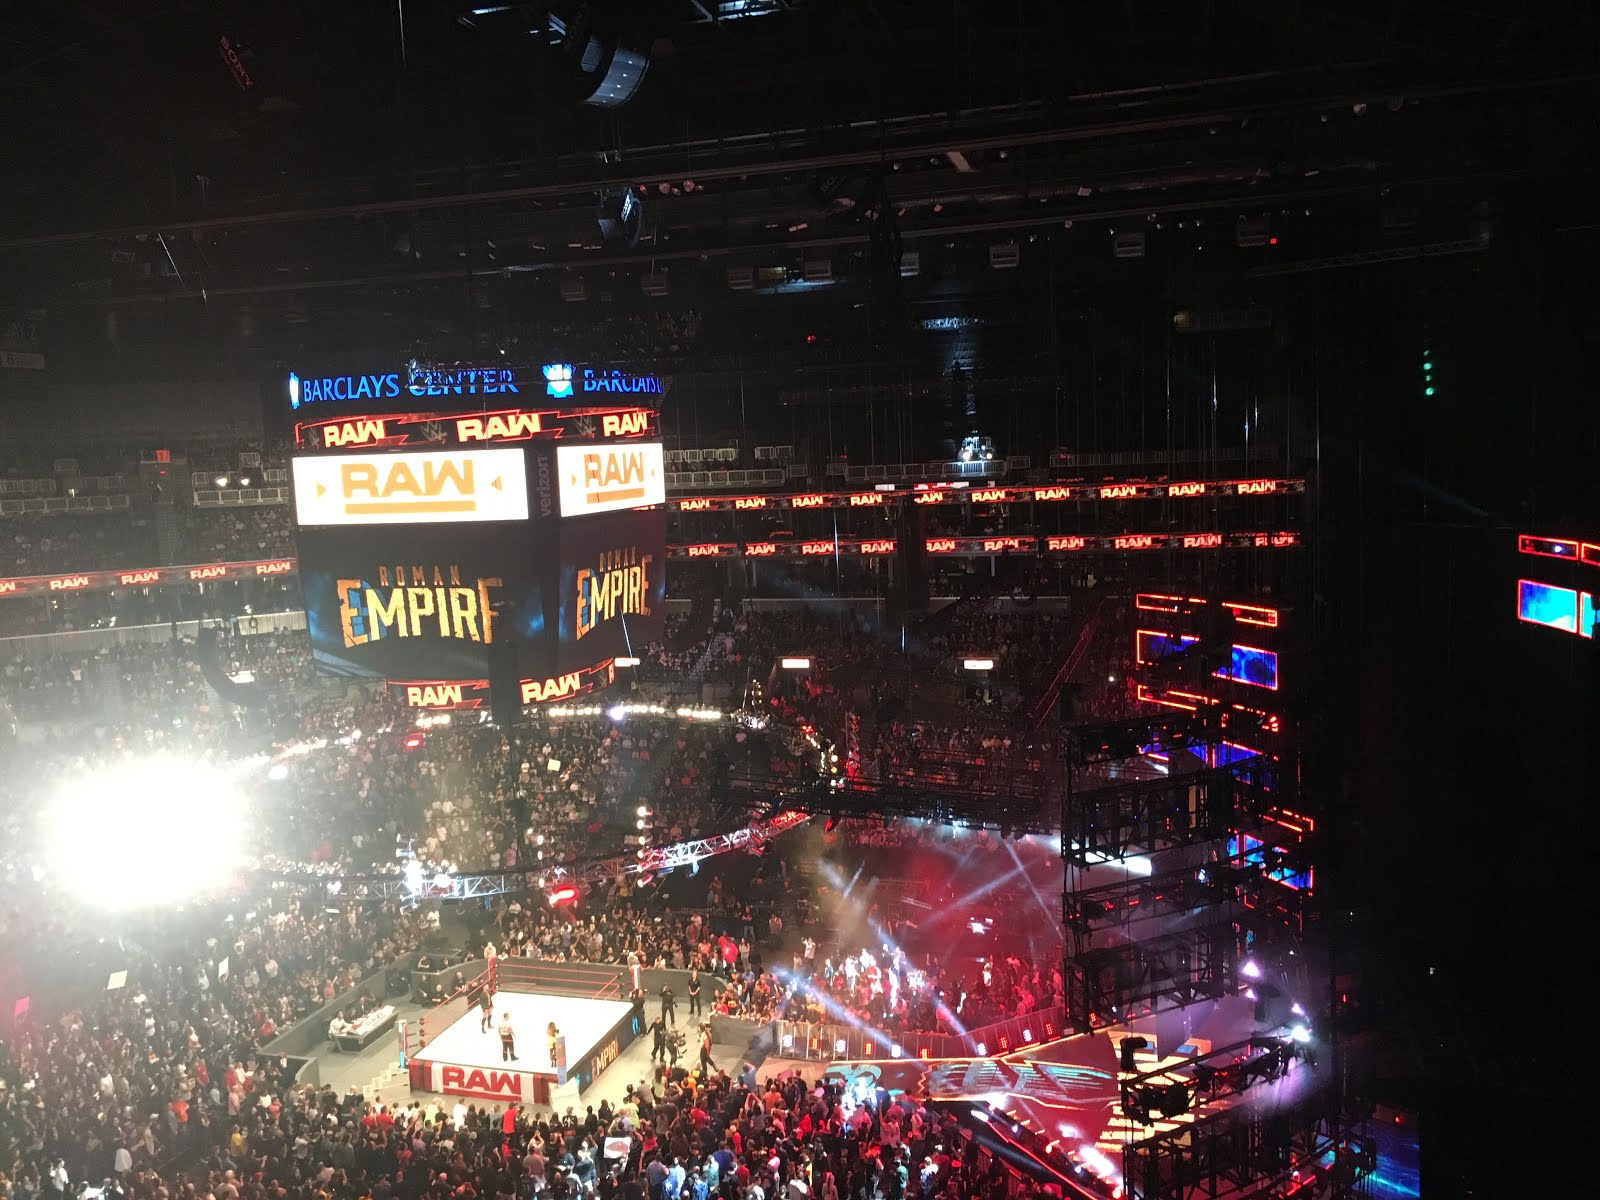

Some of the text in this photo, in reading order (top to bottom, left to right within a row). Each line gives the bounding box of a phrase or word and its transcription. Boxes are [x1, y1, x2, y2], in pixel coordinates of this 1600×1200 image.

[303, 369, 519, 402] BARCLAYS CENTER
[583, 369, 656, 393] BARCLAYS
[456, 413, 541, 443] RAW
[602, 412, 648, 437] RAW
[324, 420, 385, 448] RAW
[584, 452, 645, 489] RAW
[341, 458, 475, 499] RAW
[537, 456, 552, 518] verizon
[1035, 487, 1070, 501] RAW
[1101, 485, 1136, 499] RAW
[1168, 483, 1205, 497] RAW
[1238, 481, 1276, 495] RAW
[792, 496, 824, 508] RAW
[850, 494, 883, 506] RAW
[972, 490, 1006, 503] RAW
[680, 499, 710, 511] RAW
[736, 498, 766, 510] RAW
[802, 543, 834, 555] RAW
[861, 541, 894, 554] RAW
[1048, 537, 1085, 551] RAW
[1115, 536, 1152, 549] RAW
[688, 545, 719, 557] RAW
[599, 546, 637, 573] ROMAN
[190, 566, 226, 580] RAW
[256, 561, 291, 575] RAW
[121, 571, 159, 585] RAW
[378, 564, 461, 587] ROMAN
[50, 576, 89, 590] RAW
[576, 554, 653, 641] EMPIRE
[520, 671, 581, 705] RAW
[407, 685, 463, 707] RAW
[442, 1065, 522, 1096] RAW
